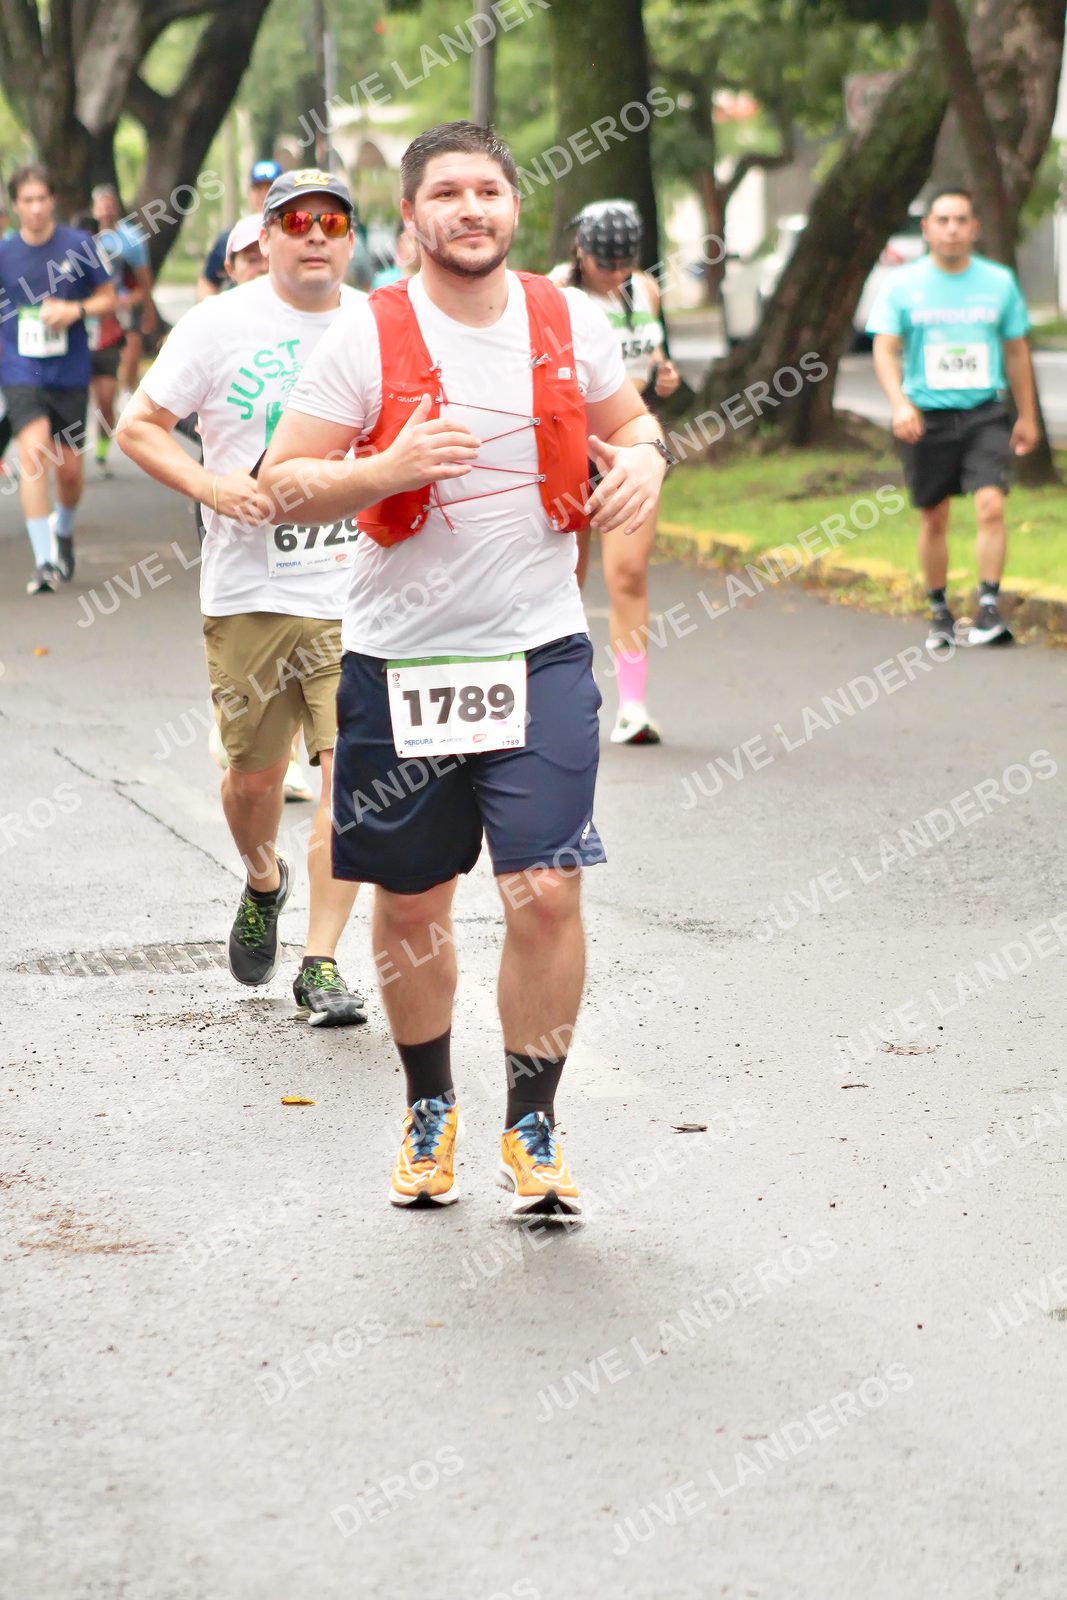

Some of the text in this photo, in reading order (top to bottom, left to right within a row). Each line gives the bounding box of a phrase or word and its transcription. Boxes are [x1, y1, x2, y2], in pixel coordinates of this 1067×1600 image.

[226, 339, 301, 420] JUST
[402, 683, 515, 727] 1789
[404, 738, 434, 747] PERDURA
[501, 739, 520, 747] 1789
